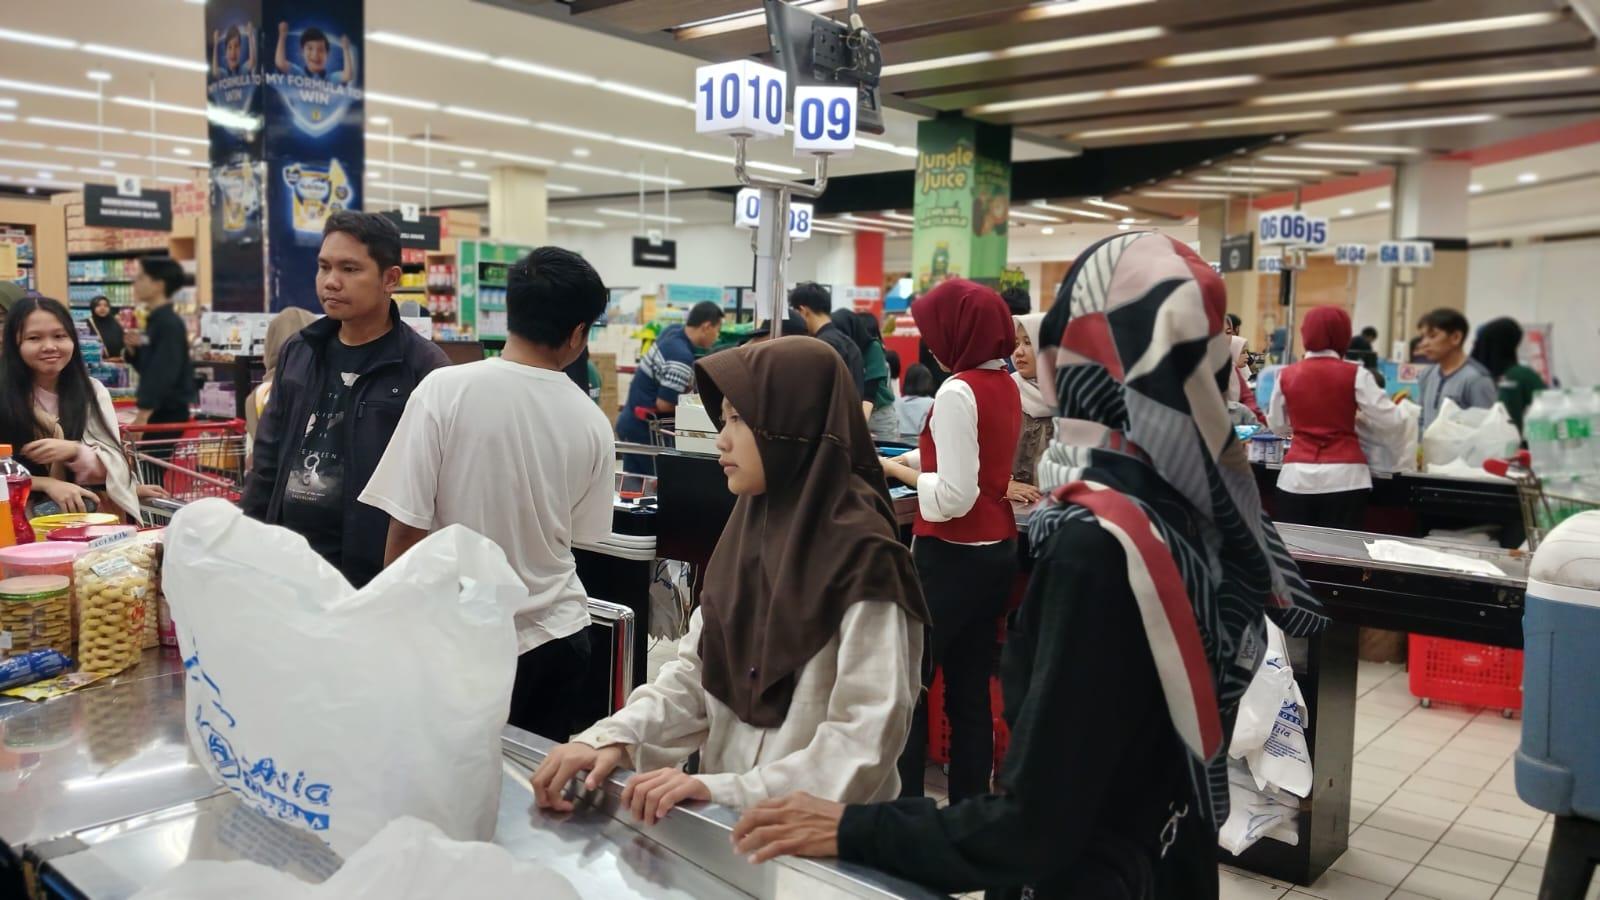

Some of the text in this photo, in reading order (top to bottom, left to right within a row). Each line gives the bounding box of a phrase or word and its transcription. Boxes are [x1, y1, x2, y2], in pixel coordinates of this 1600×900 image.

[265, 72, 364, 99] MY FORMULA TO
[300, 90, 330, 105] WIN
[700, 73, 740, 121] 10
[748, 75, 783, 125] 10
[800, 97, 851, 140] 09
[918, 147, 974, 174] Jungle
[923, 171, 966, 195] Juice
[407, 206, 415, 217] 7
[1261, 216, 1277, 240] 06
[1281, 215, 1304, 238] 06
[250, 757, 333, 806] Asia
